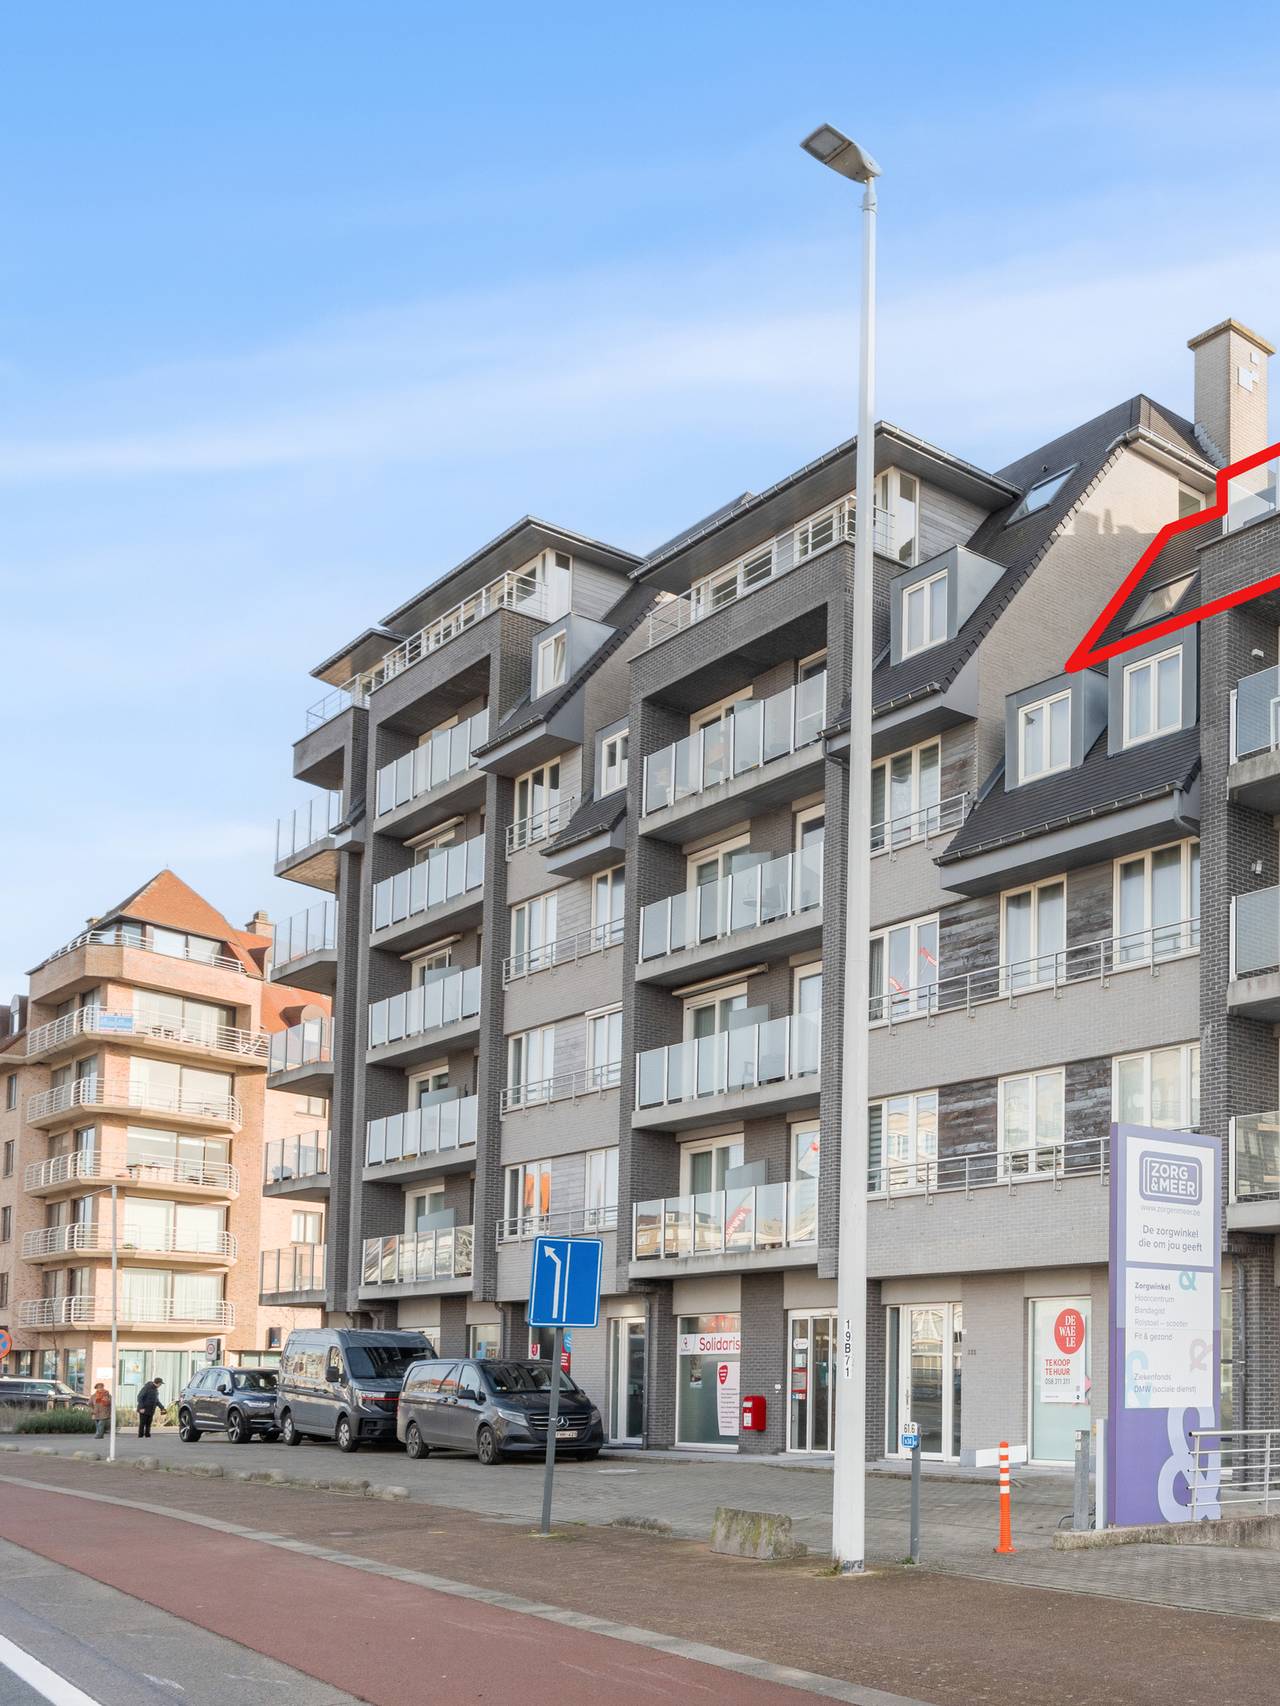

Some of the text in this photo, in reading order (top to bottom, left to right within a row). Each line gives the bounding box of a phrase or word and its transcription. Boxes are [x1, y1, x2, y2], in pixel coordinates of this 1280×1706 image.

[1151, 1163, 1188, 1179] ZORG
[1150, 1177, 1196, 1195] &MEER
[1143, 1225, 1199, 1238] De zorgwinkel
[1139, 1238, 1202, 1253] die om jou geeft
[1134, 1282, 1171, 1291] Zorgwinkel
[1065, 1315, 1076, 1326] DE
[1059, 1326, 1076, 1337] WAE
[699, 1337, 740, 1351] Solidaris
[1066, 1337, 1076, 1347] LE
[1045, 1359, 1071, 1367] TE KOOP
[1045, 1368, 1071, 1376] TE HUUR
[1134, 1385, 1151, 1393] DMW
[903, 1423, 916, 1434] 61.6
